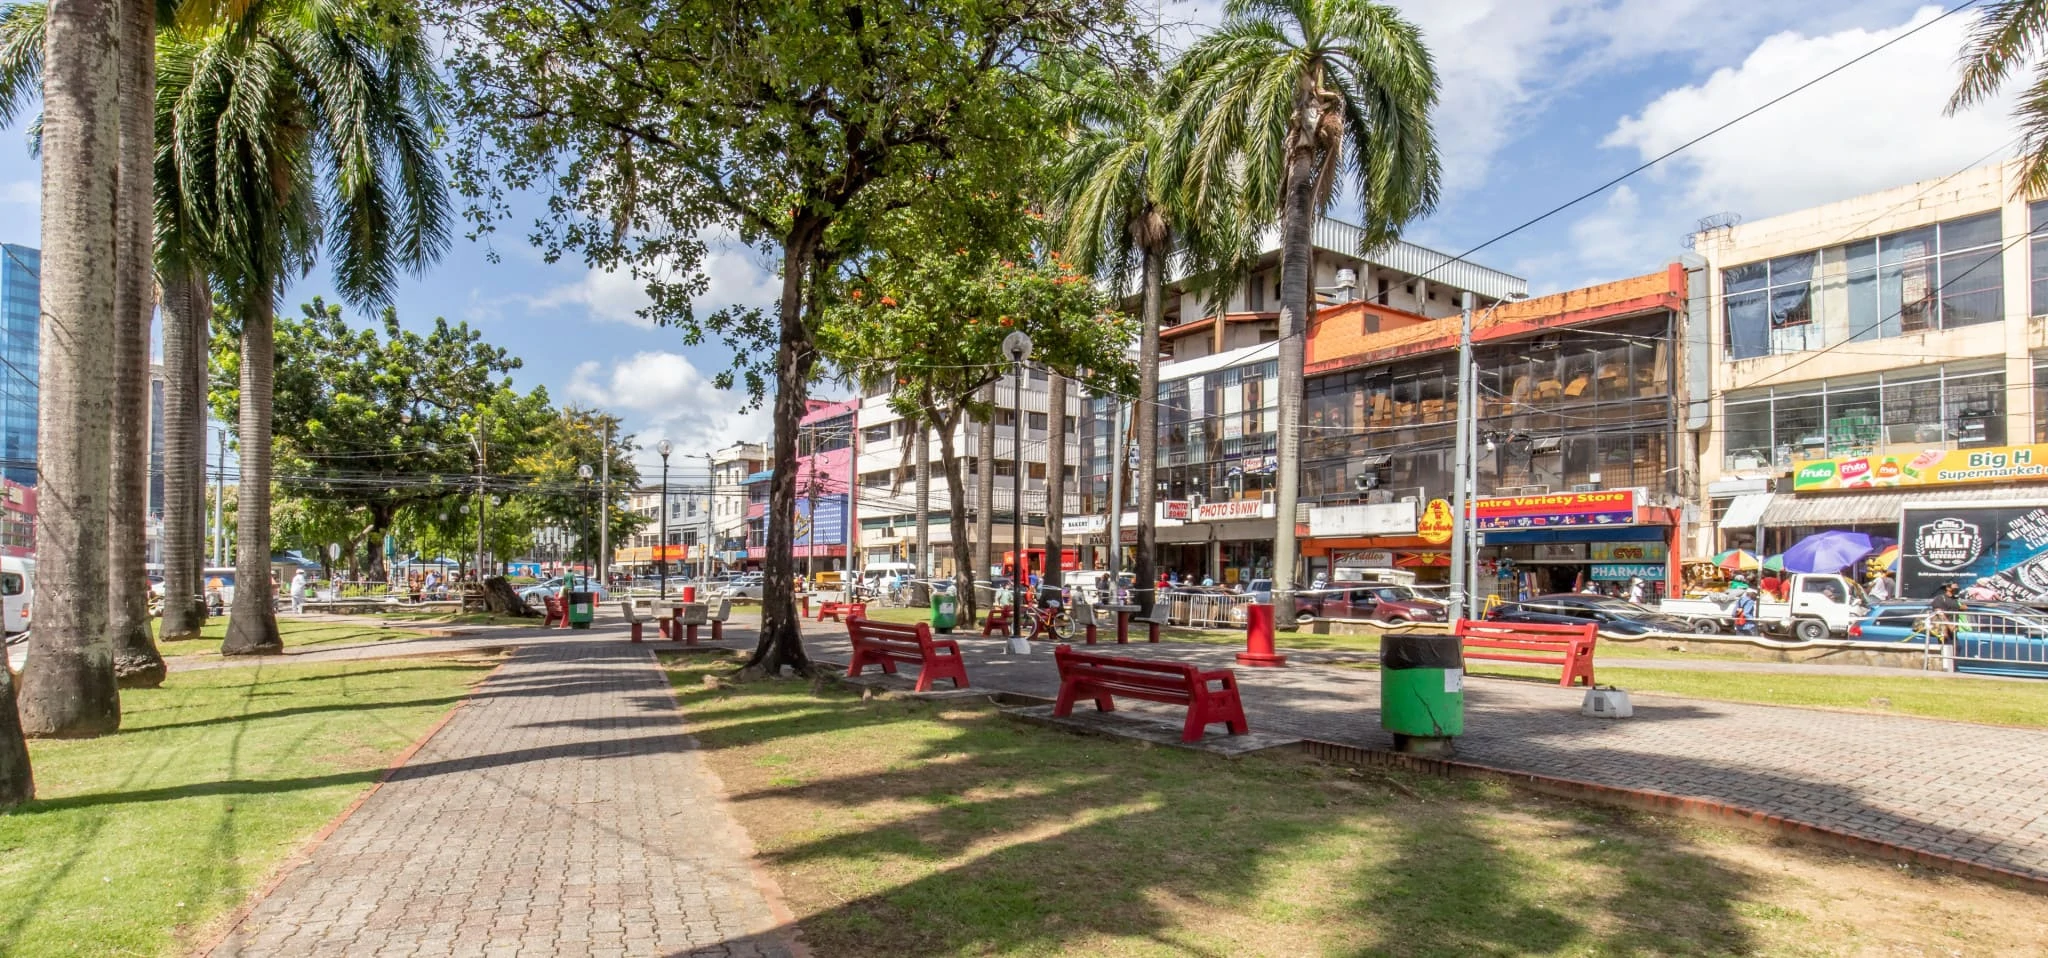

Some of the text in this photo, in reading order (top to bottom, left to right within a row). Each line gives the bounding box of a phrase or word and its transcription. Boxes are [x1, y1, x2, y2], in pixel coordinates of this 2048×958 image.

[1969, 450, 2030, 468] Big H
[1801, 469, 1832, 478] Fruta
[1841, 462, 1867, 473] Fruta
[1938, 465, 2042, 480] Supermarket
[1514, 496, 1573, 507] Variety
[1576, 493, 1625, 503] Store
[1200, 502, 1259, 517] PHOTO SONNY
[1924, 533, 1973, 549] MALT
[1613, 547, 1643, 559] CVS
[1592, 566, 1665, 577] PHARMACY
